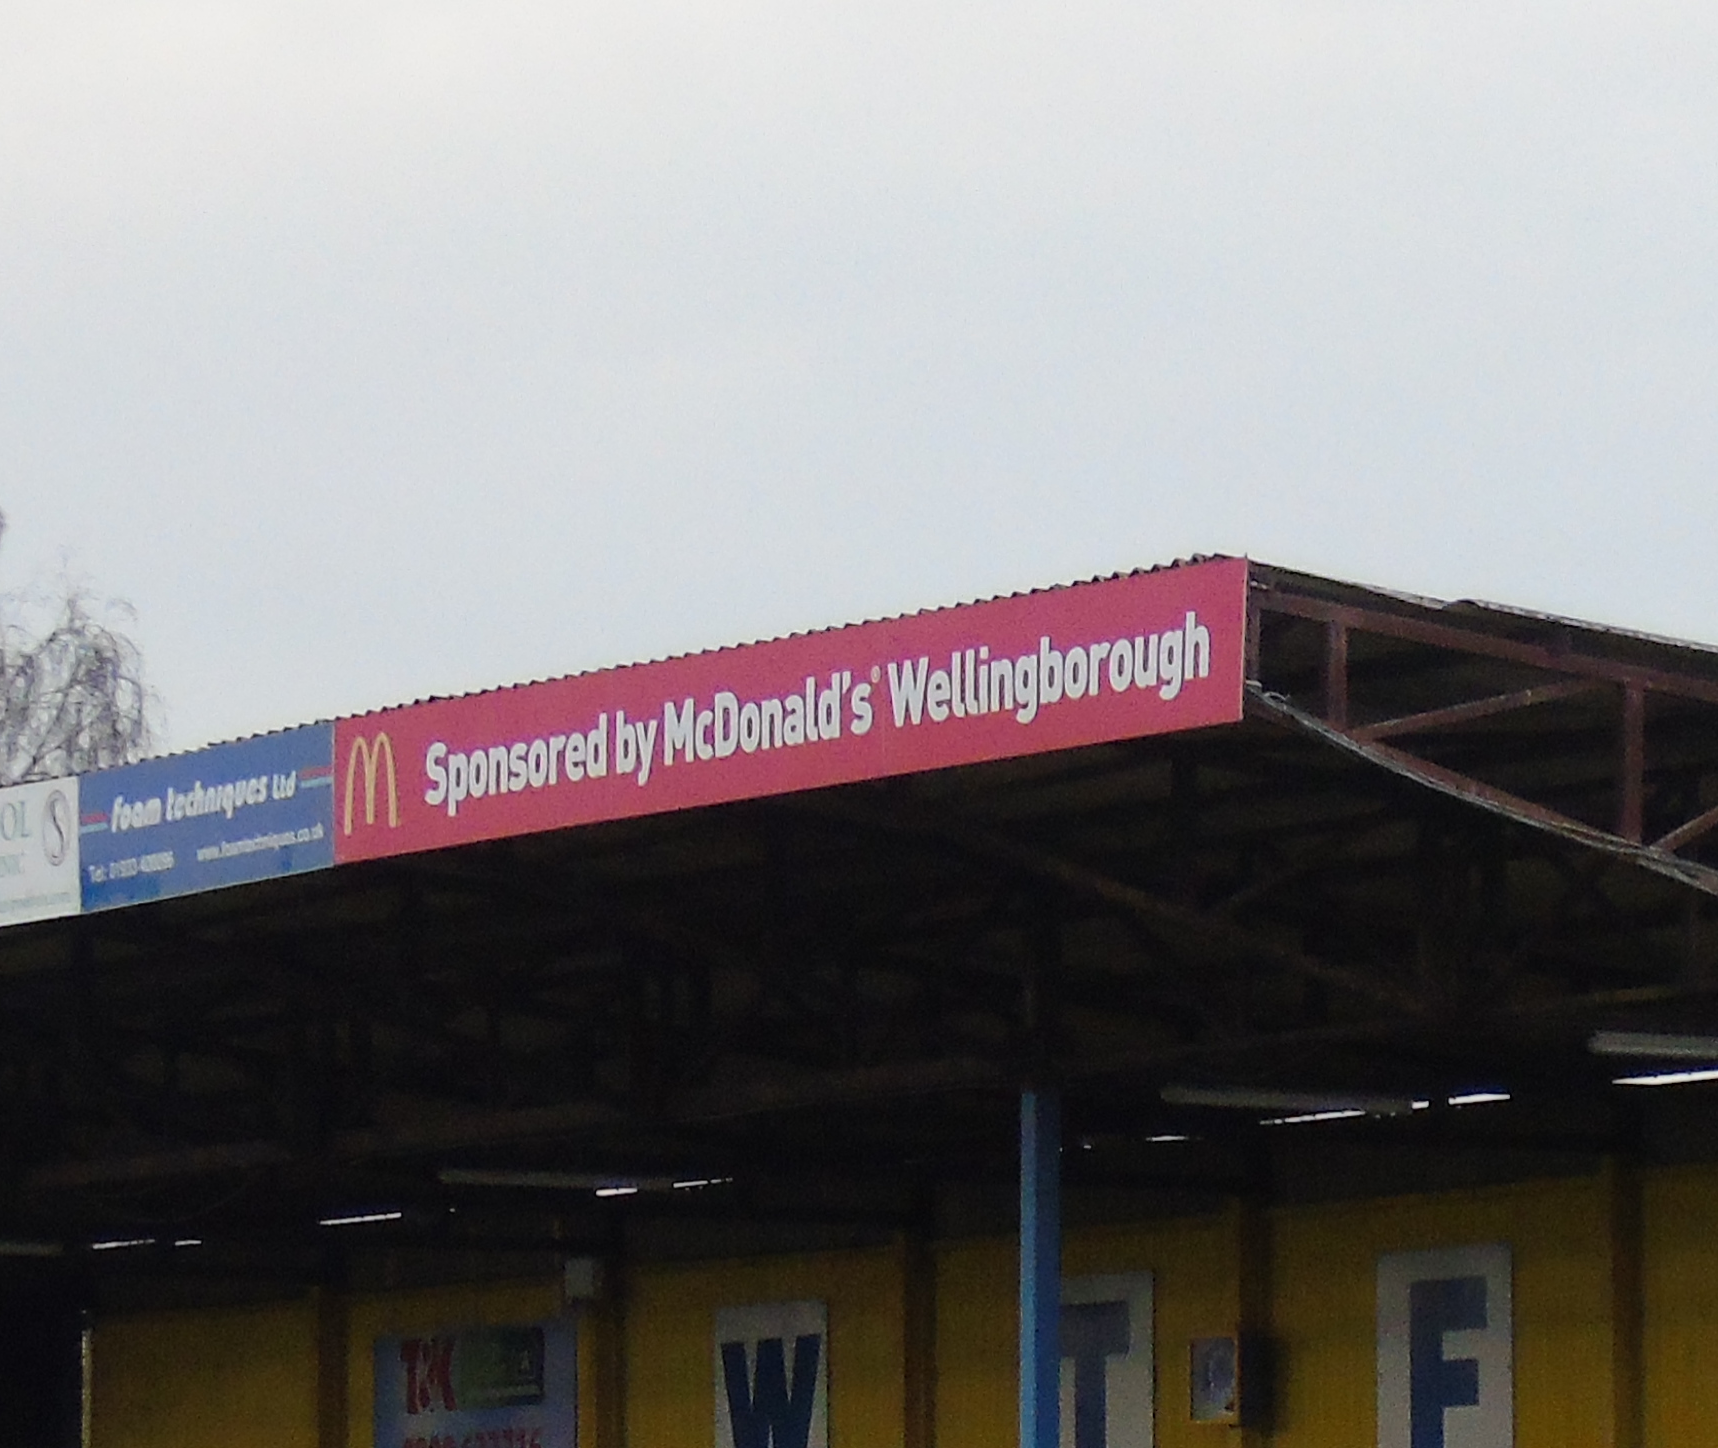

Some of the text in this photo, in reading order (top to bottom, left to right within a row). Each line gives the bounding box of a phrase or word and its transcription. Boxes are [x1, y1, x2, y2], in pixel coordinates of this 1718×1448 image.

[425, 712, 608, 817] Sponsored
[615, 710, 657, 787] by
[887, 611, 1210, 728] Wellingborough
[112, 770, 296, 832] foam techniques Ltd
